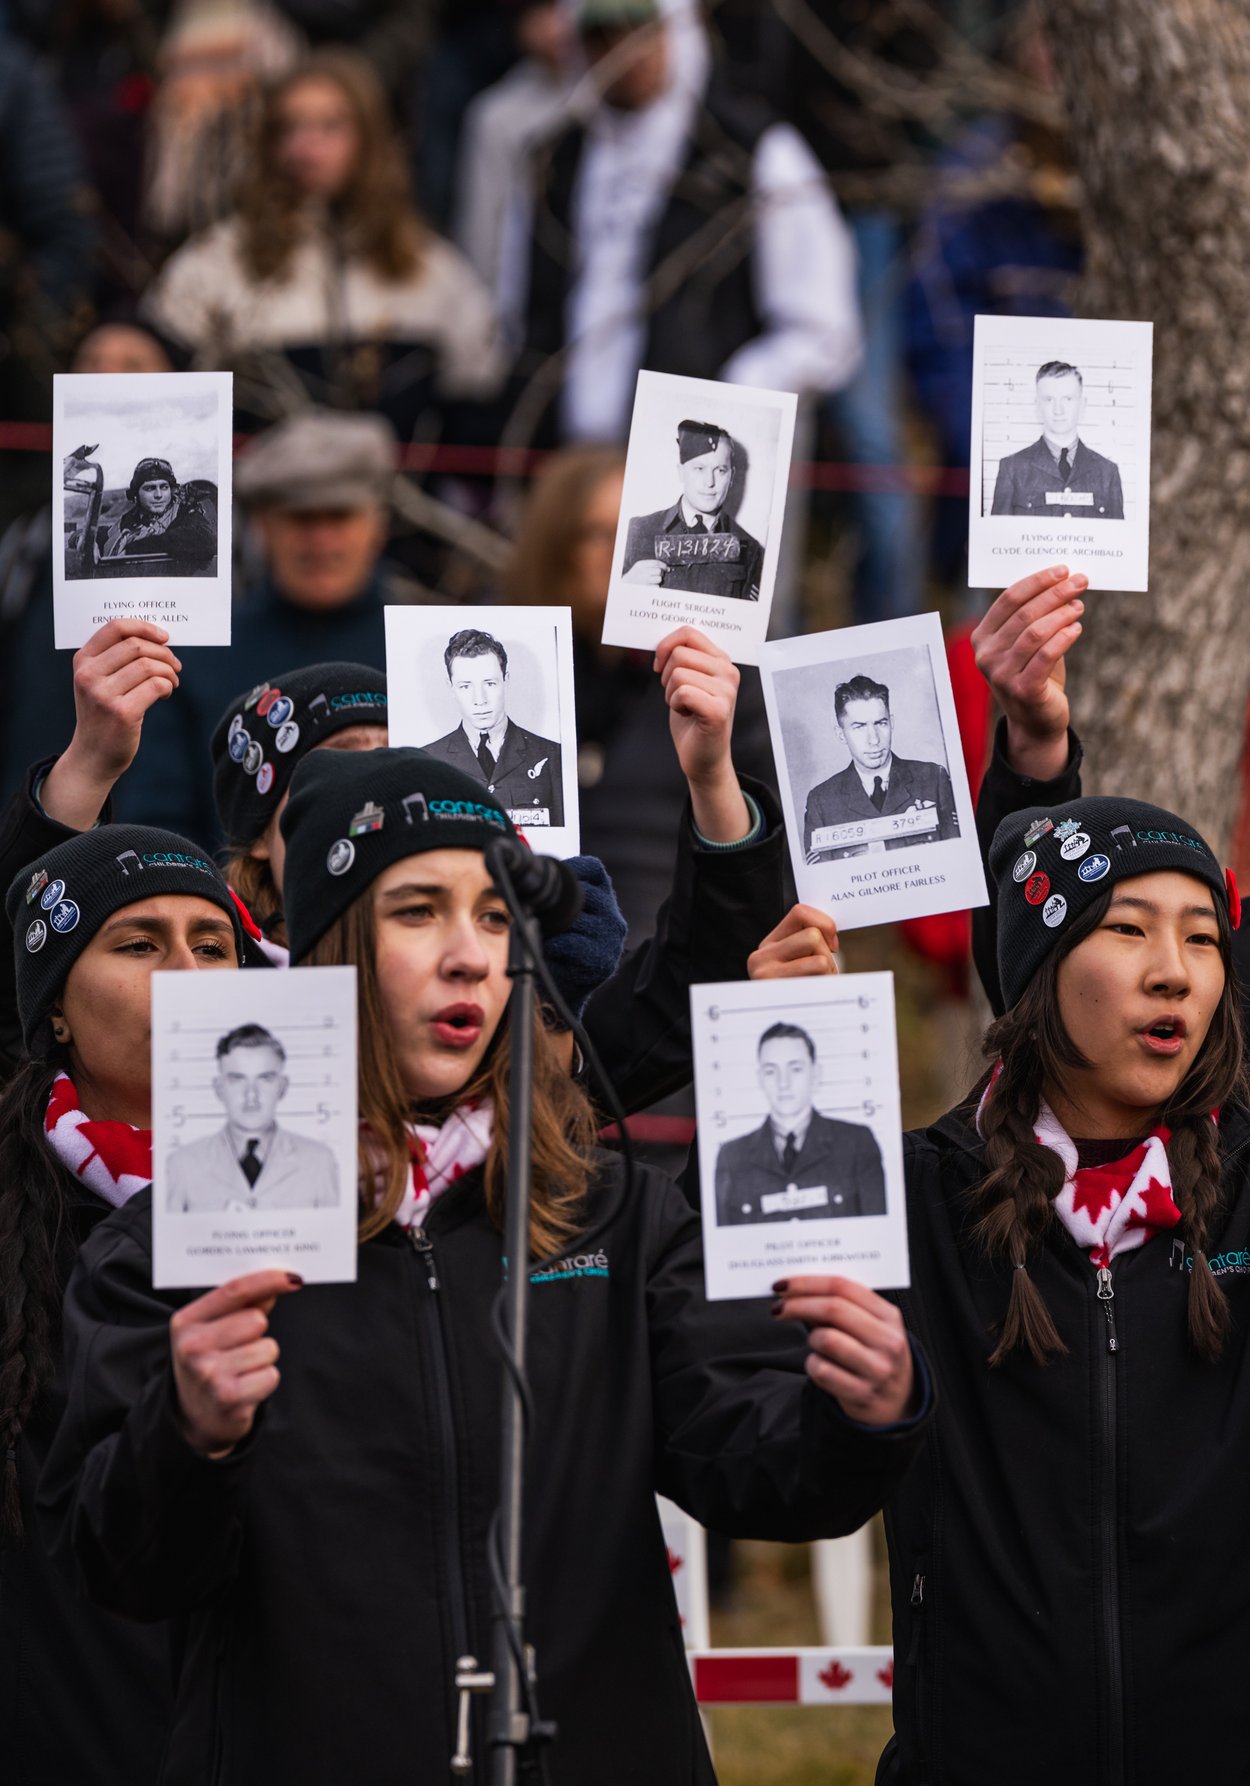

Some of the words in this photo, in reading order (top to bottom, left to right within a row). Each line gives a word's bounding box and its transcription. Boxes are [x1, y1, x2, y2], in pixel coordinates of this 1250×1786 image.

[1021, 534, 1053, 543] FLYING
[1056, 534, 1095, 543] OFFICER
[658, 537, 736, 558] R-131824
[992, 547, 1021, 555] CLYDE
[1024, 547, 1068, 556] GLENCOE
[1072, 548, 1124, 558] ARCHIBALD
[103, 601, 135, 609] FLYING
[138, 600, 177, 609] OFFICER
[651, 598, 681, 609] FLIGHT
[684, 603, 726, 616] SERGEANT
[160, 614, 189, 622] ALLEN
[629, 609, 658, 620] LLOYD
[661, 613, 696, 625] GEORGE
[699, 618, 742, 632] ANDERSON
[851, 872, 877, 884] PILOT
[881, 864, 921, 878] OFFICER
[830, 890, 855, 902] ALAN
[858, 882, 901, 897] GILMORE
[904, 874, 946, 889] FAIRLESS
[212, 1229, 249, 1240] FLYING
[252, 1228, 296, 1239] OFFICER
[797, 1237, 841, 1249] OFFICER
[1186, 1247, 1250, 1272] cntaré
